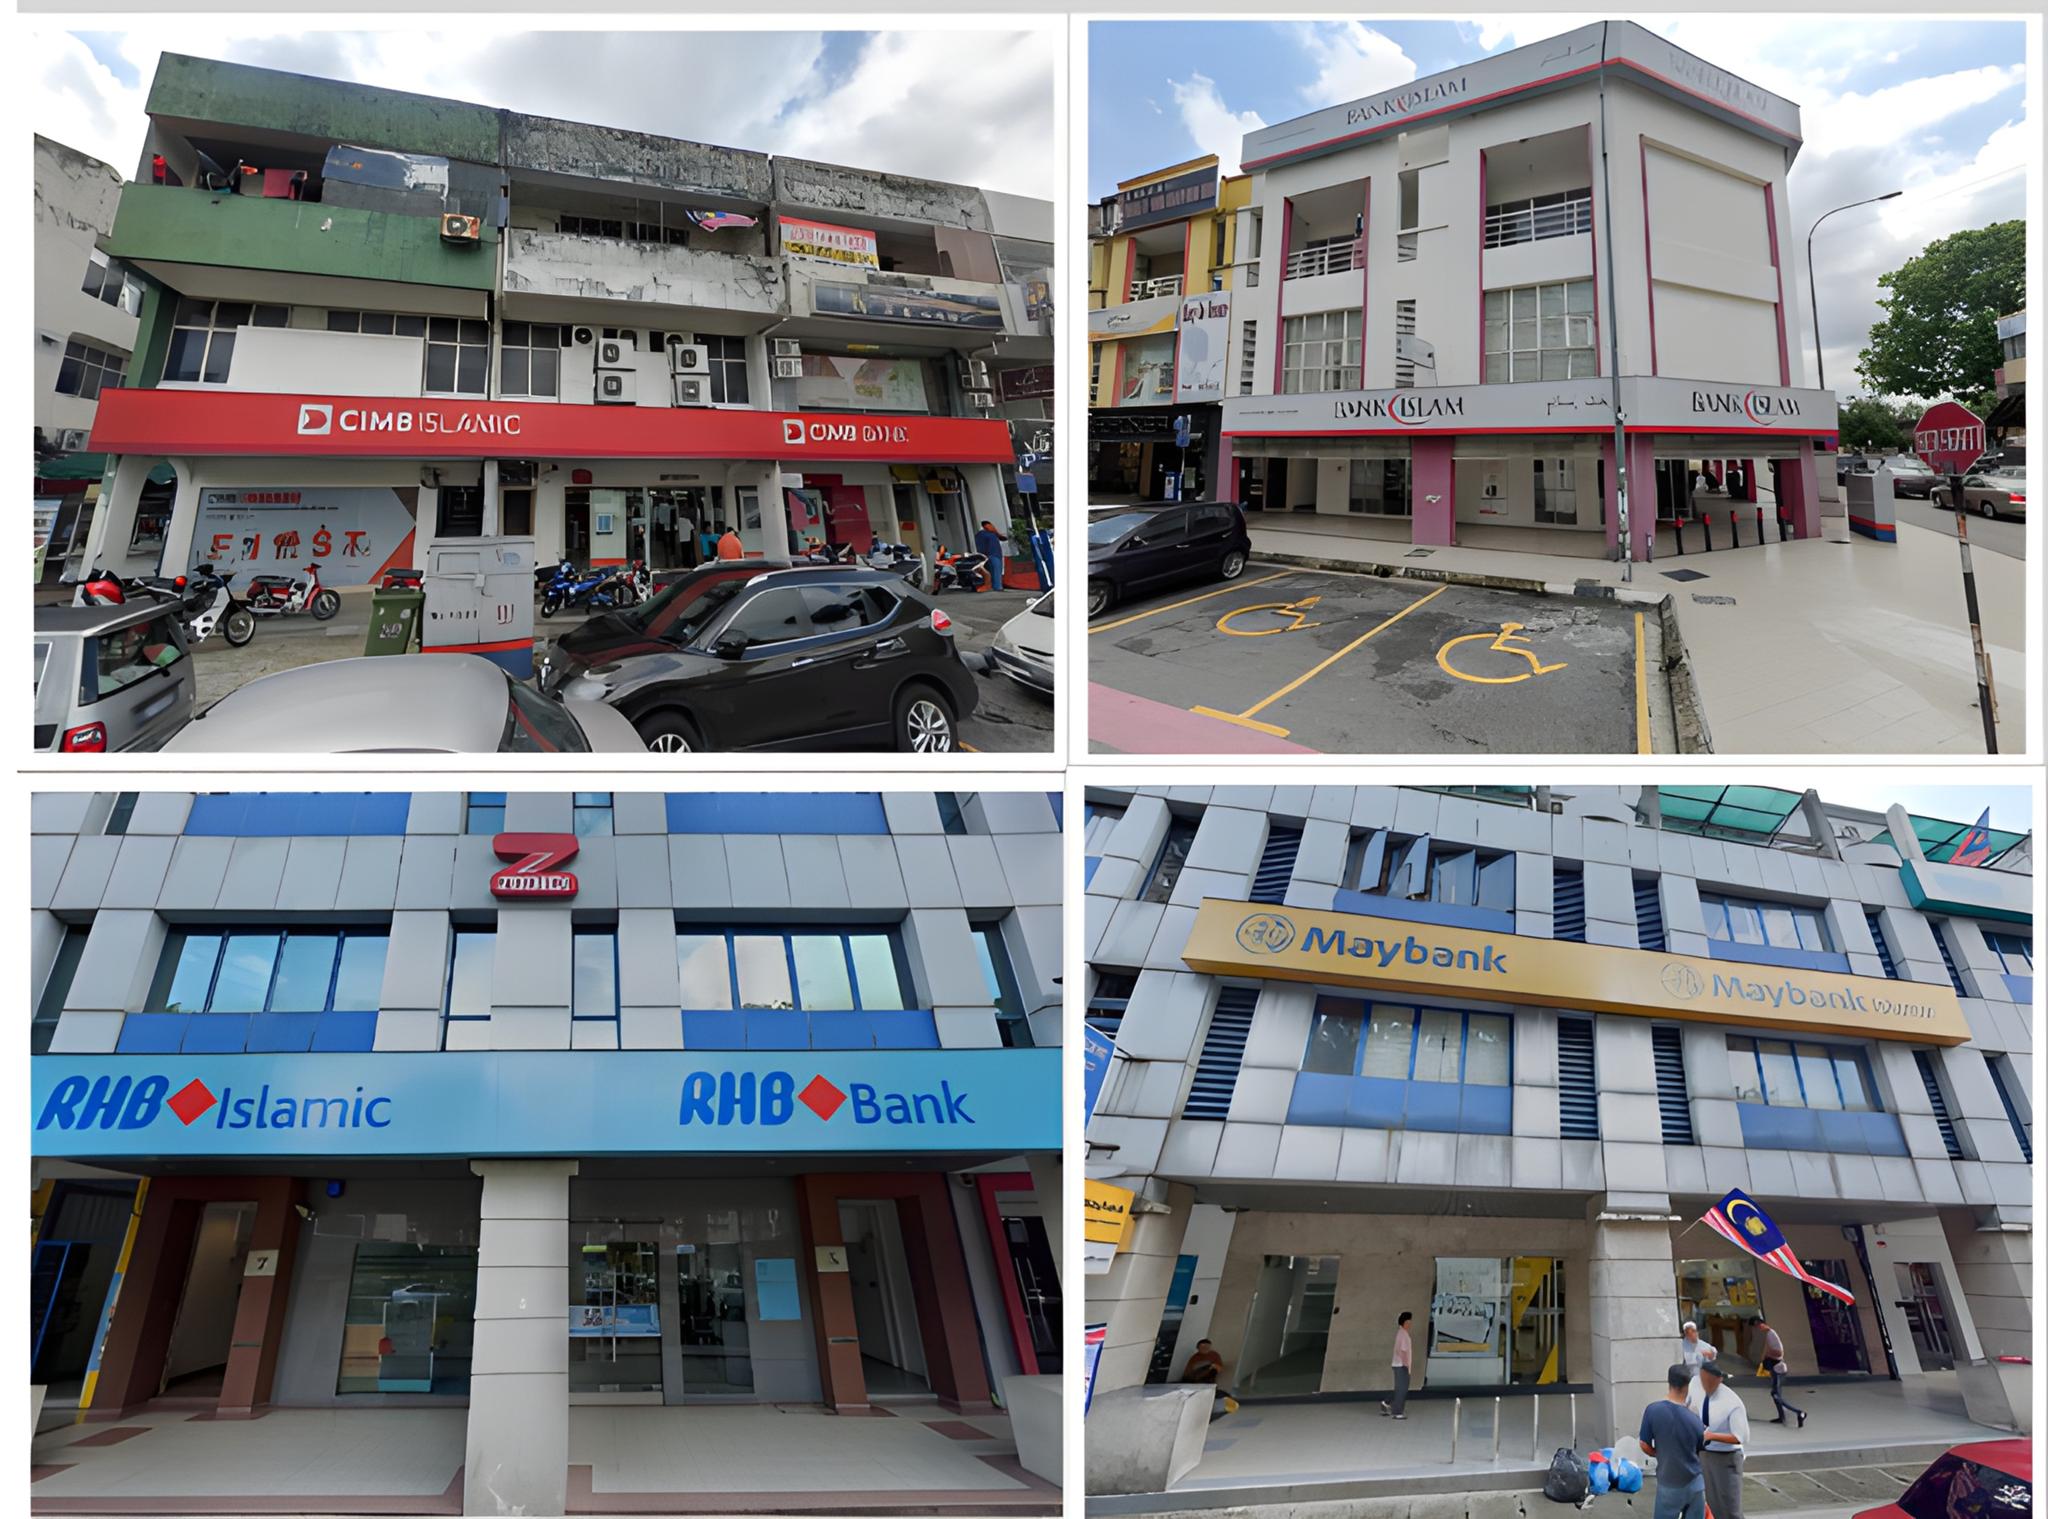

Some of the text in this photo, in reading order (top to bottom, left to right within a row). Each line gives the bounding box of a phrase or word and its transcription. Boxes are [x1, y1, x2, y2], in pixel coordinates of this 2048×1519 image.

[339, 409, 413, 432] CIMB
[1300, 926, 1509, 975] Maybank
[1712, 973, 1868, 1012] Maybank
[36, 1075, 392, 1131] RHB Islamic
[679, 1071, 976, 1126] RHB Bank
